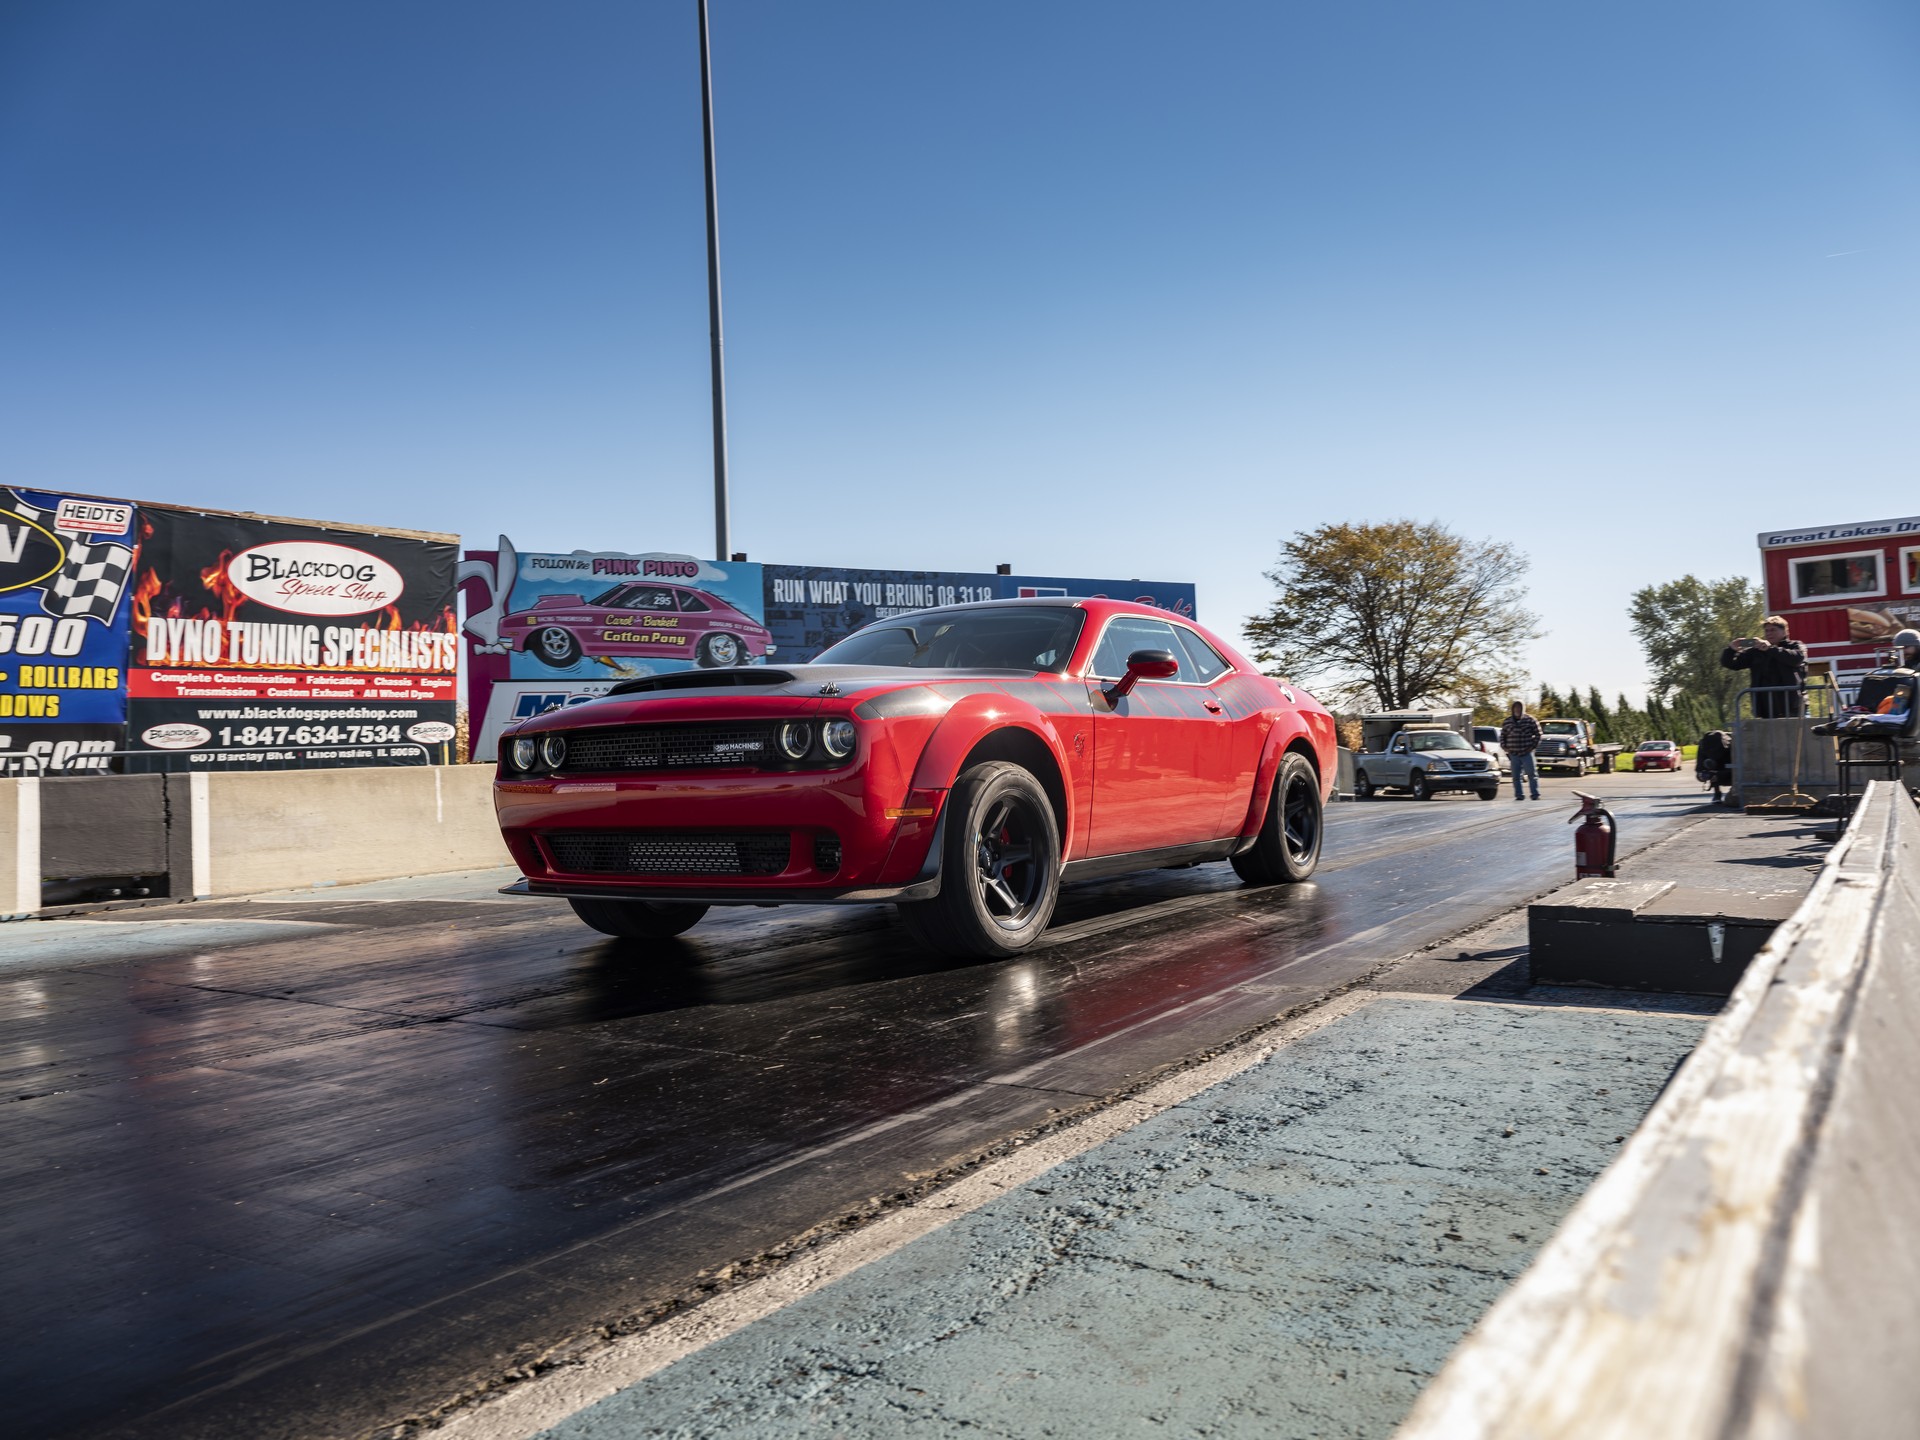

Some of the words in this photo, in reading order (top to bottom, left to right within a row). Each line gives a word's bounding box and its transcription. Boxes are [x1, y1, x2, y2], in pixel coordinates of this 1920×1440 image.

[62, 504, 126, 522] HEIDTS
[1767, 530, 1826, 545] Great
[1828, 525, 1893, 539] Lakes
[246, 553, 377, 582] BLACKDOG
[531, 558, 576, 569] FOLLOW
[576, 560, 590, 570] the
[592, 558, 641, 575] PINK
[643, 560, 699, 577] PINTO
[275, 579, 340, 604] Speed
[339, 583, 389, 608] Shop
[774, 579, 805, 603] RUN
[808, 580, 850, 604] WHAT
[853, 582, 882, 606] YOU
[886, 584, 934, 607] BRUNG
[605, 614, 635, 626] Carol
[643, 615, 680, 627] Burkett
[146, 617, 222, 664] DYNO
[227, 621, 320, 667] TUNING
[323, 626, 456, 671] SPECIALISTS
[603, 630, 650, 642] Cotton
[651, 632, 686, 646] Pony
[19, 665, 119, 689] ROLLBARS
[151, 672, 212, 684] Complete
[214, 673, 297, 684] Customization
[306, 676, 366, 685] Fabrication
[374, 677, 413, 687] Chassis
[420, 678, 453, 688] Engine
[176, 686, 257, 697] Transmission
[267, 688, 310, 697] Custom
[312, 688, 354, 698] Exhaust
[363, 689, 377, 698] All
[379, 690, 409, 698] Wheel
[410, 690, 435, 699] Dyno
[197, 707, 418, 721] www.blackdogspeedshop.com
[219, 725, 401, 745] 1-847-634-7534
[730, 742, 760, 750] MACHINES
[217, 752, 265, 762] Barclay
